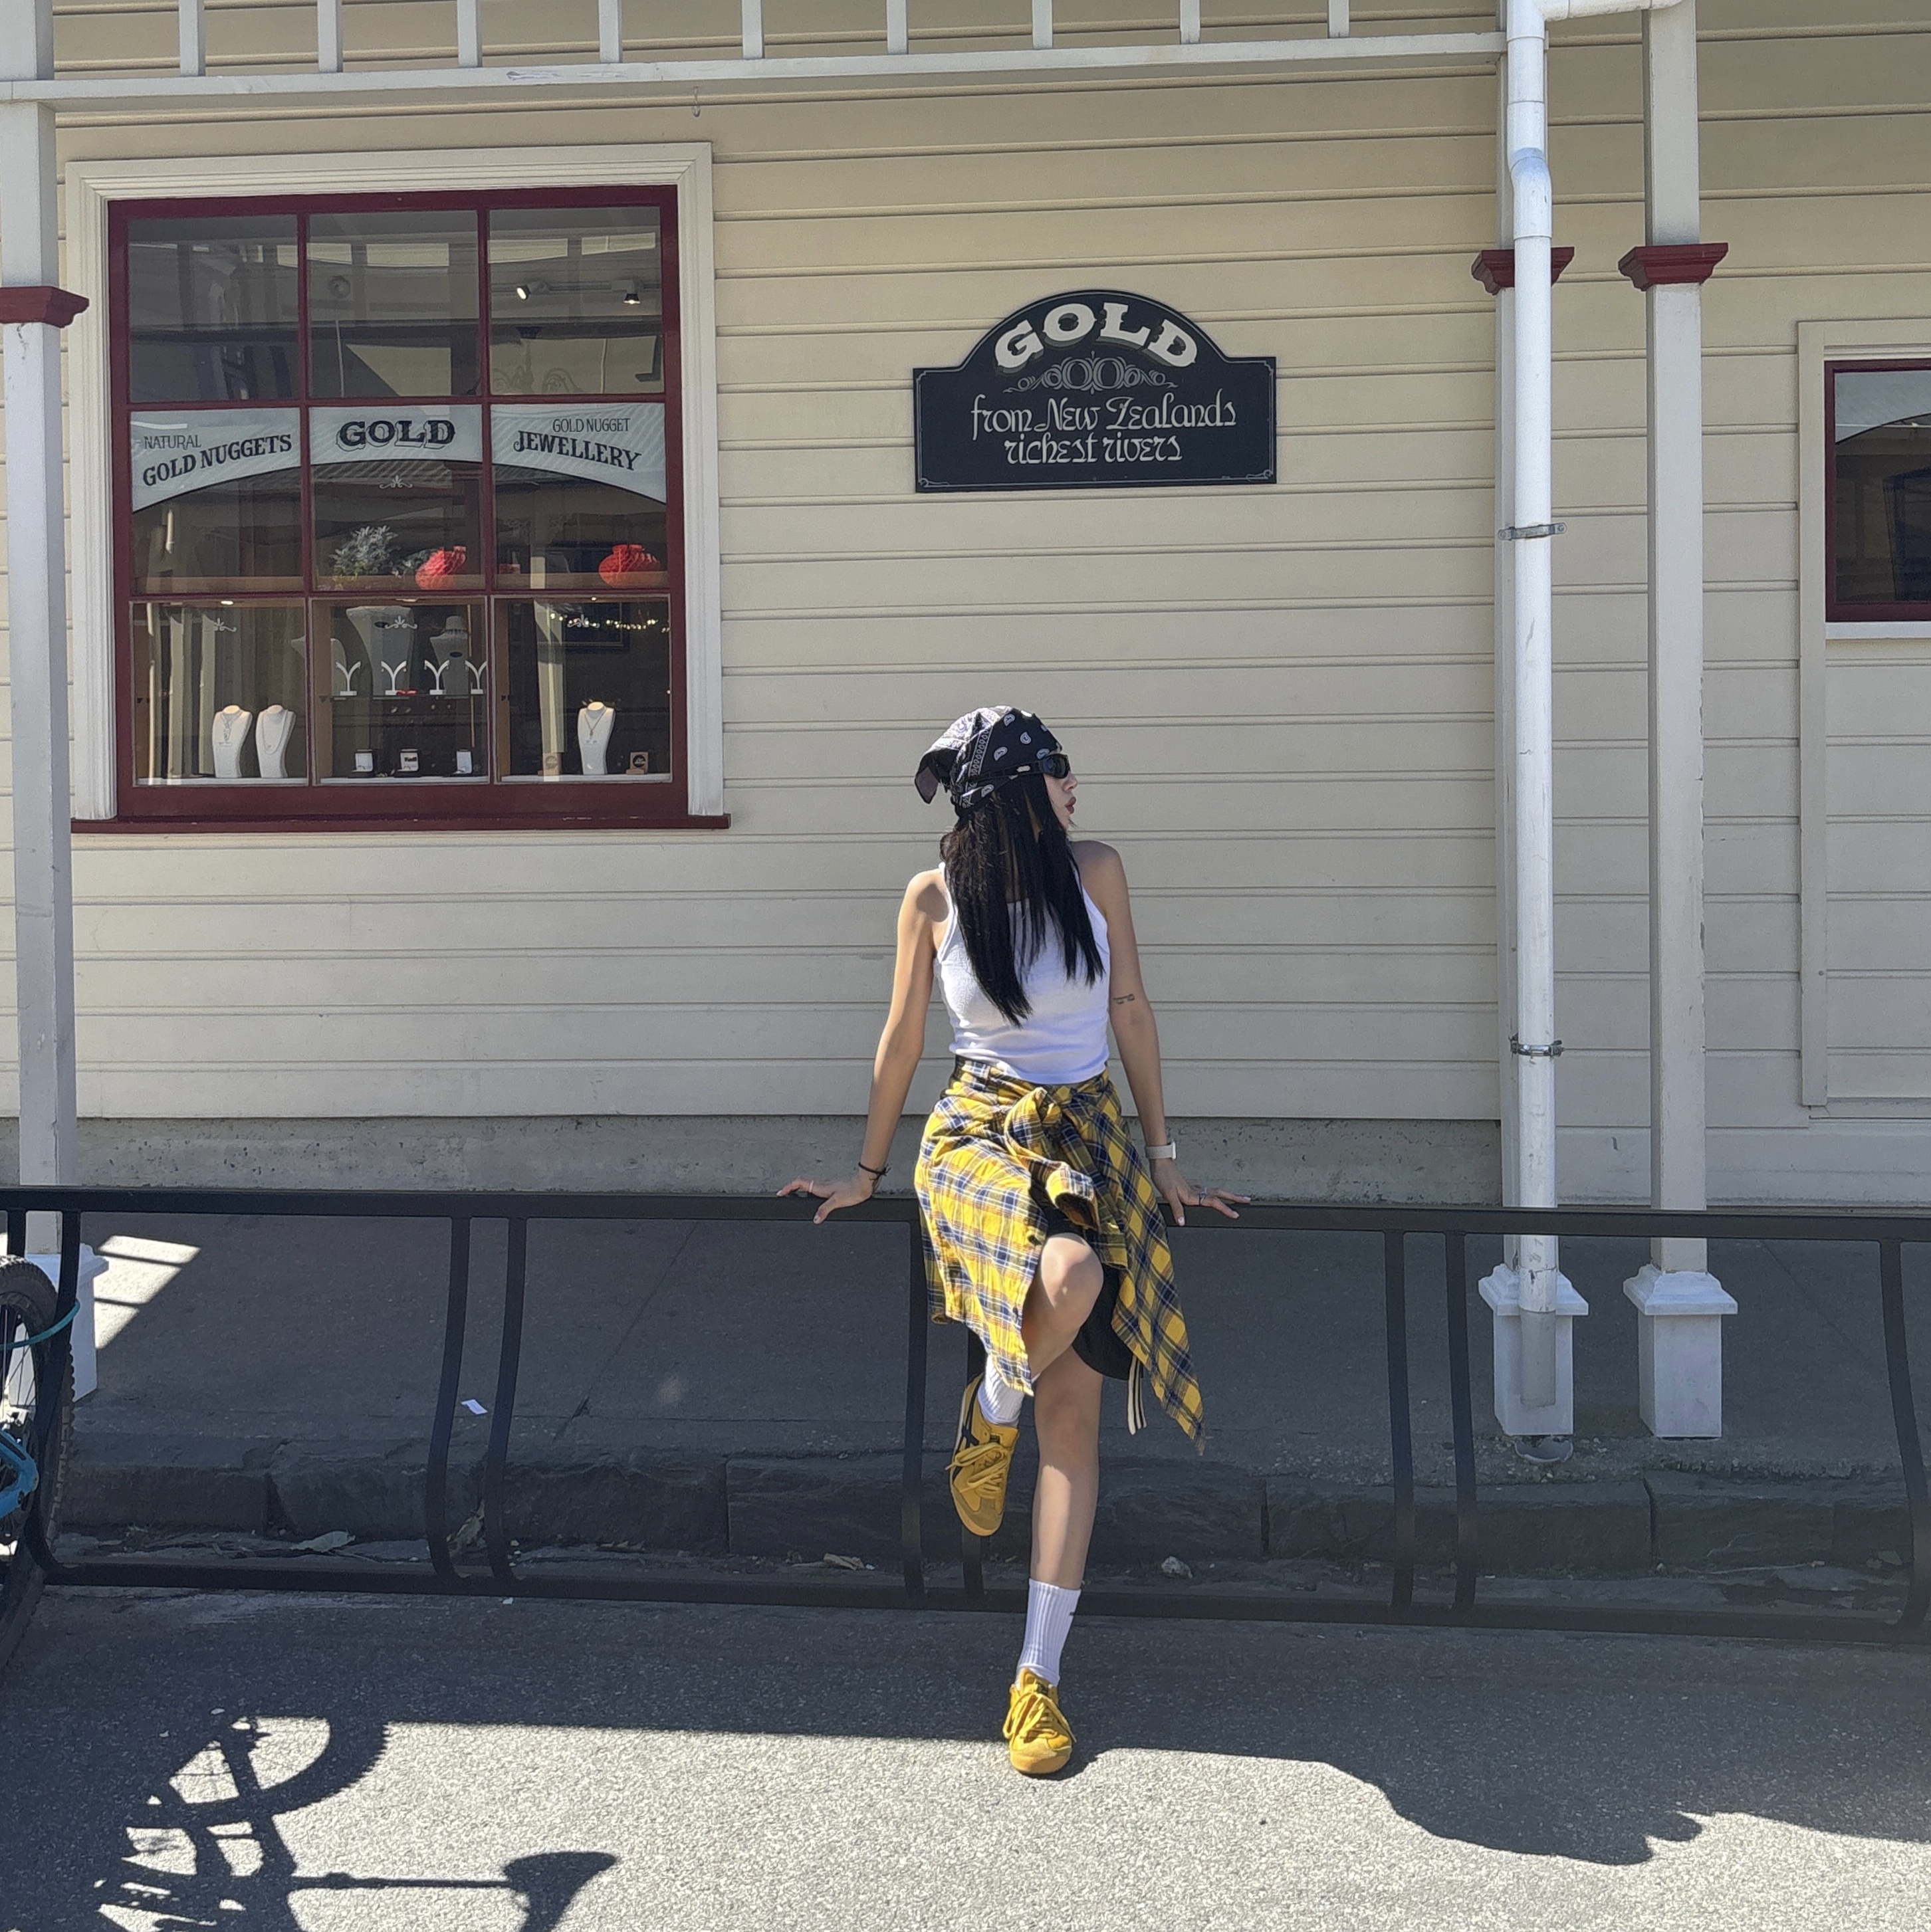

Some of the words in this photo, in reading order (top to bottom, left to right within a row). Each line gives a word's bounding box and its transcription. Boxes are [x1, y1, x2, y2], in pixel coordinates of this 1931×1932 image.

[994, 302, 1198, 370] GOLD
[552, 419, 585, 432] GOLD
[586, 418, 631, 432] NUGGET
[970, 393, 1033, 441] from
[1034, 397, 1101, 433] New
[1105, 388, 1237, 430] Zealands
[144, 434, 202, 451] NATURAL
[336, 420, 456, 452] GOLD
[513, 430, 642, 471] JEWELLERY
[1004, 432, 1097, 464] richest
[1103, 431, 1183, 463] rivers
[142, 454, 197, 486] GOLD
[200, 434, 292, 469] NUGGETS
